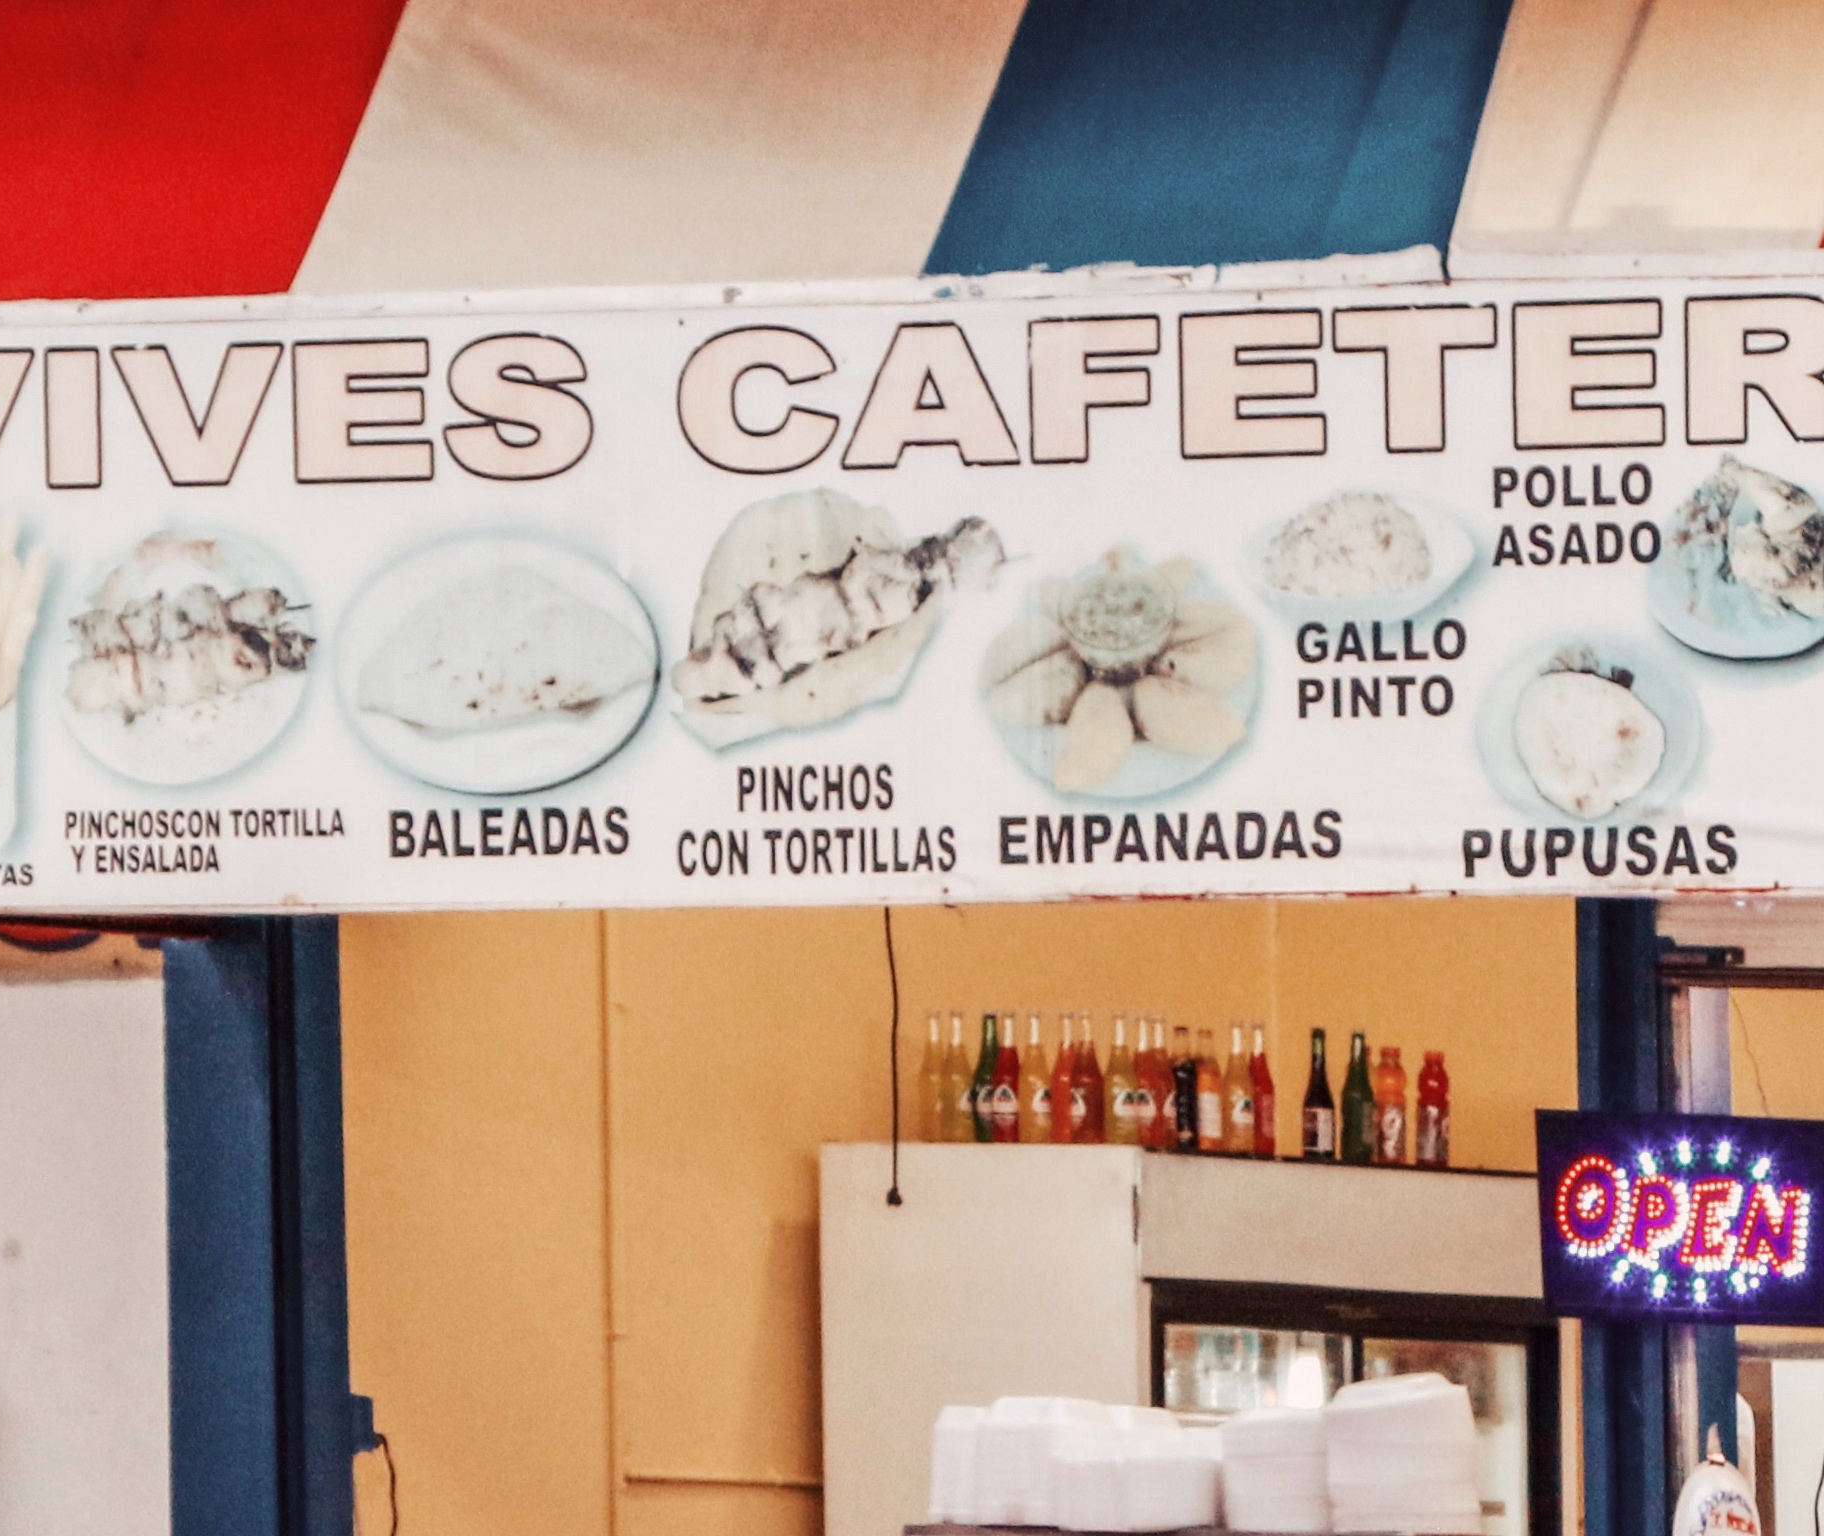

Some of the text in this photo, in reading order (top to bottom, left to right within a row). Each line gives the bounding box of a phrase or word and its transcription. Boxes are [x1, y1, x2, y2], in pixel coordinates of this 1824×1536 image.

[1493, 462, 1653, 509] POLLO
[1492, 520, 1662, 567] ASADO
[1296, 618, 1467, 664] GALLO
[1298, 675, 1454, 719] PINTO
[738, 763, 894, 813] PINCHOS
[230, 808, 345, 838] TORTILLA
[389, 806, 630, 858] BALEADAS
[999, 809, 1342, 865] EMPANADAS
[71, 844, 220, 874] Y ENSALADA
[677, 825, 957, 877] CON TORTILLAS
[1462, 824, 1738, 878] PUPUSAS
[1554, 1153, 1812, 1280] OPEN
